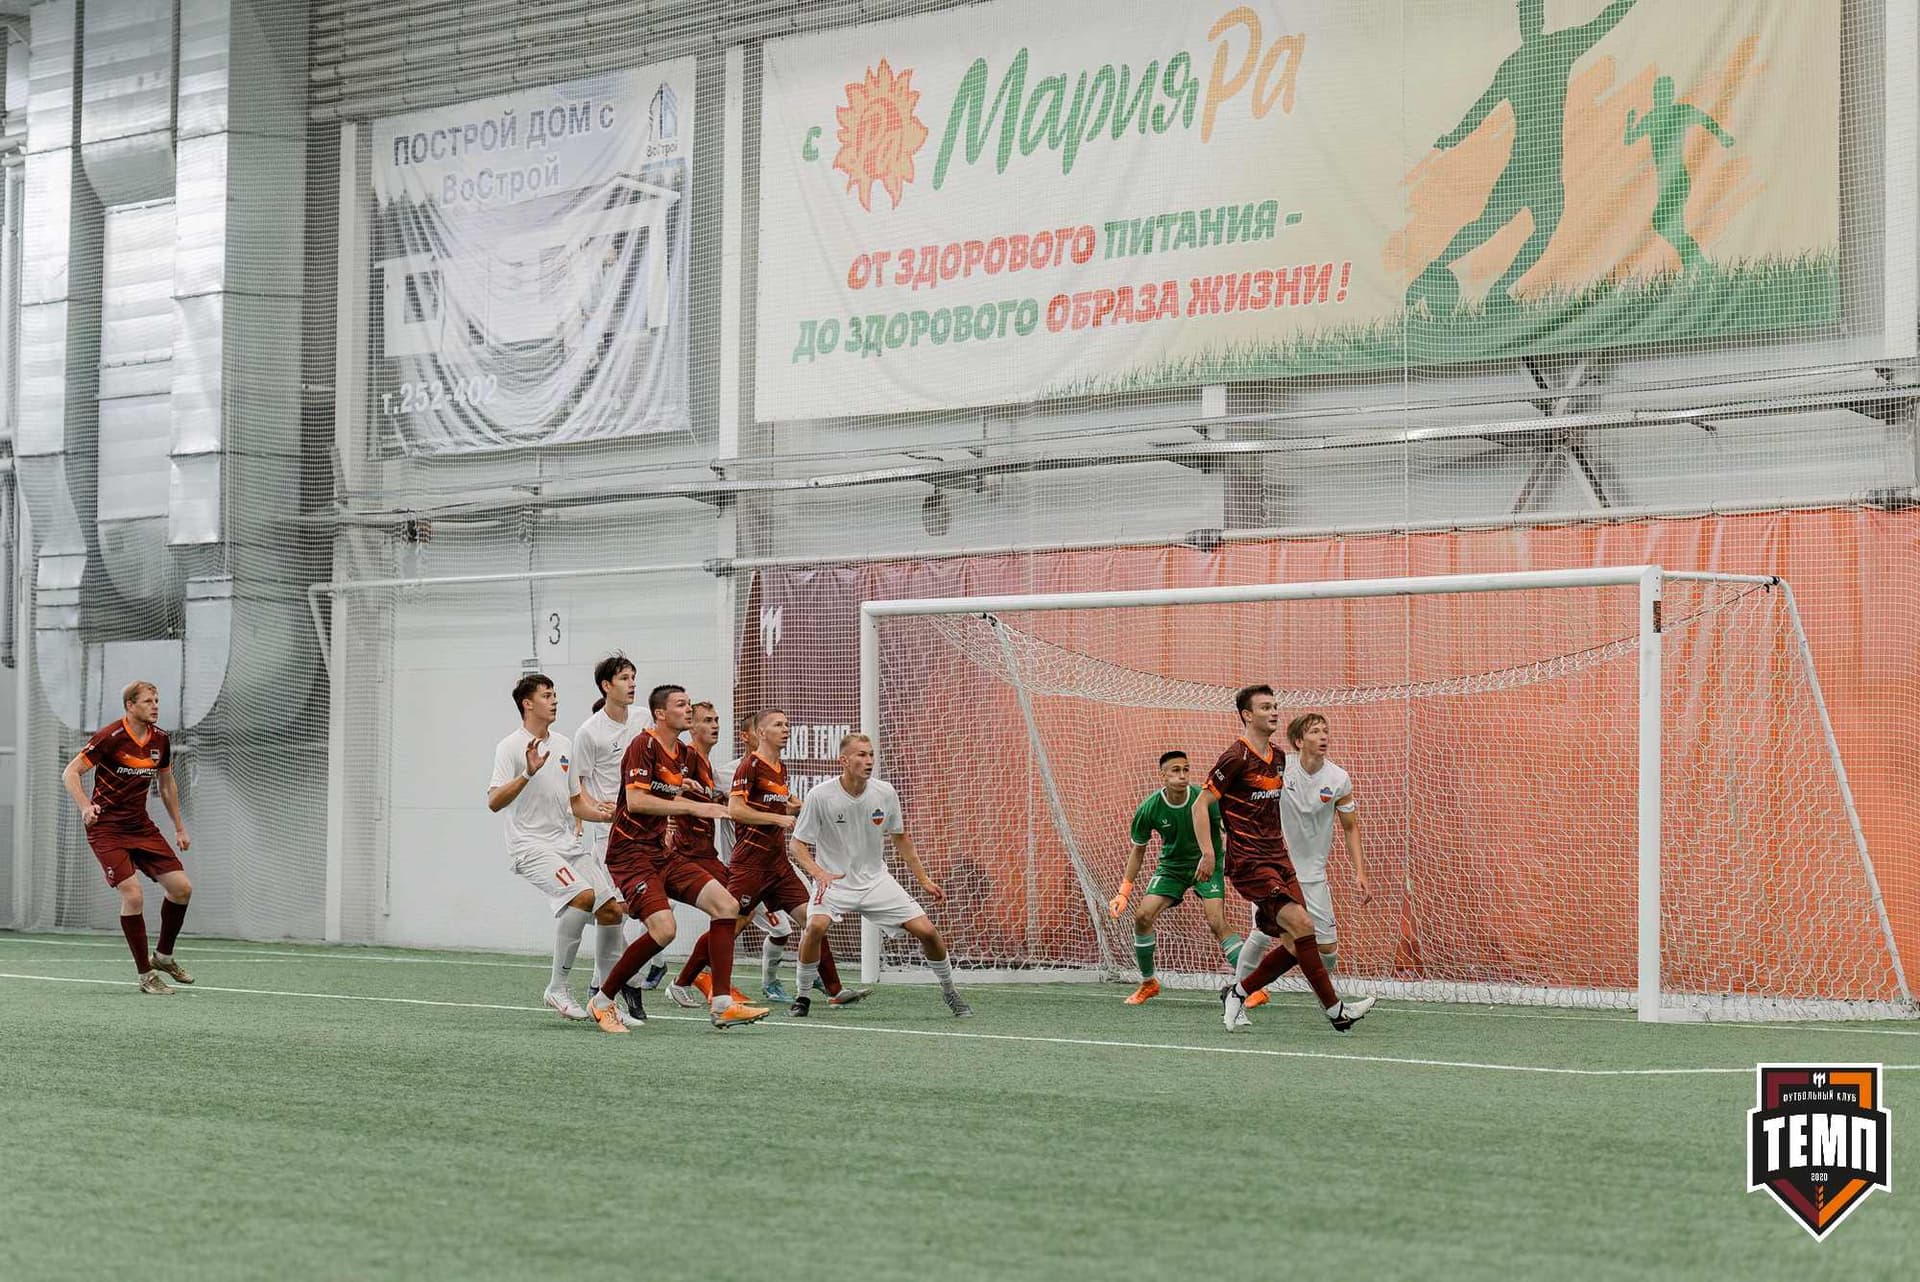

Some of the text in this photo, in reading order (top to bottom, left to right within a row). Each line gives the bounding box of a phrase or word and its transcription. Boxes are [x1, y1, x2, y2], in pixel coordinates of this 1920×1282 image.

[393, 108, 517, 167] ПОСТРОЙ
[526, 101, 591, 149] ДОМ
[441, 154, 560, 205] ВоСтрой
[847, 250, 892, 290] ОТ
[894, 223, 1097, 291] ЗДОРОВОГО
[1104, 199, 1278, 260] ПИТАНИЯ
[791, 317, 841, 364] ДО
[844, 297, 1039, 359] ЗДОРОВОГО
[1046, 280, 1180, 334] ОБРАЗА
[548, 612, 561, 645] 3
[555, 866, 576, 887] 17
